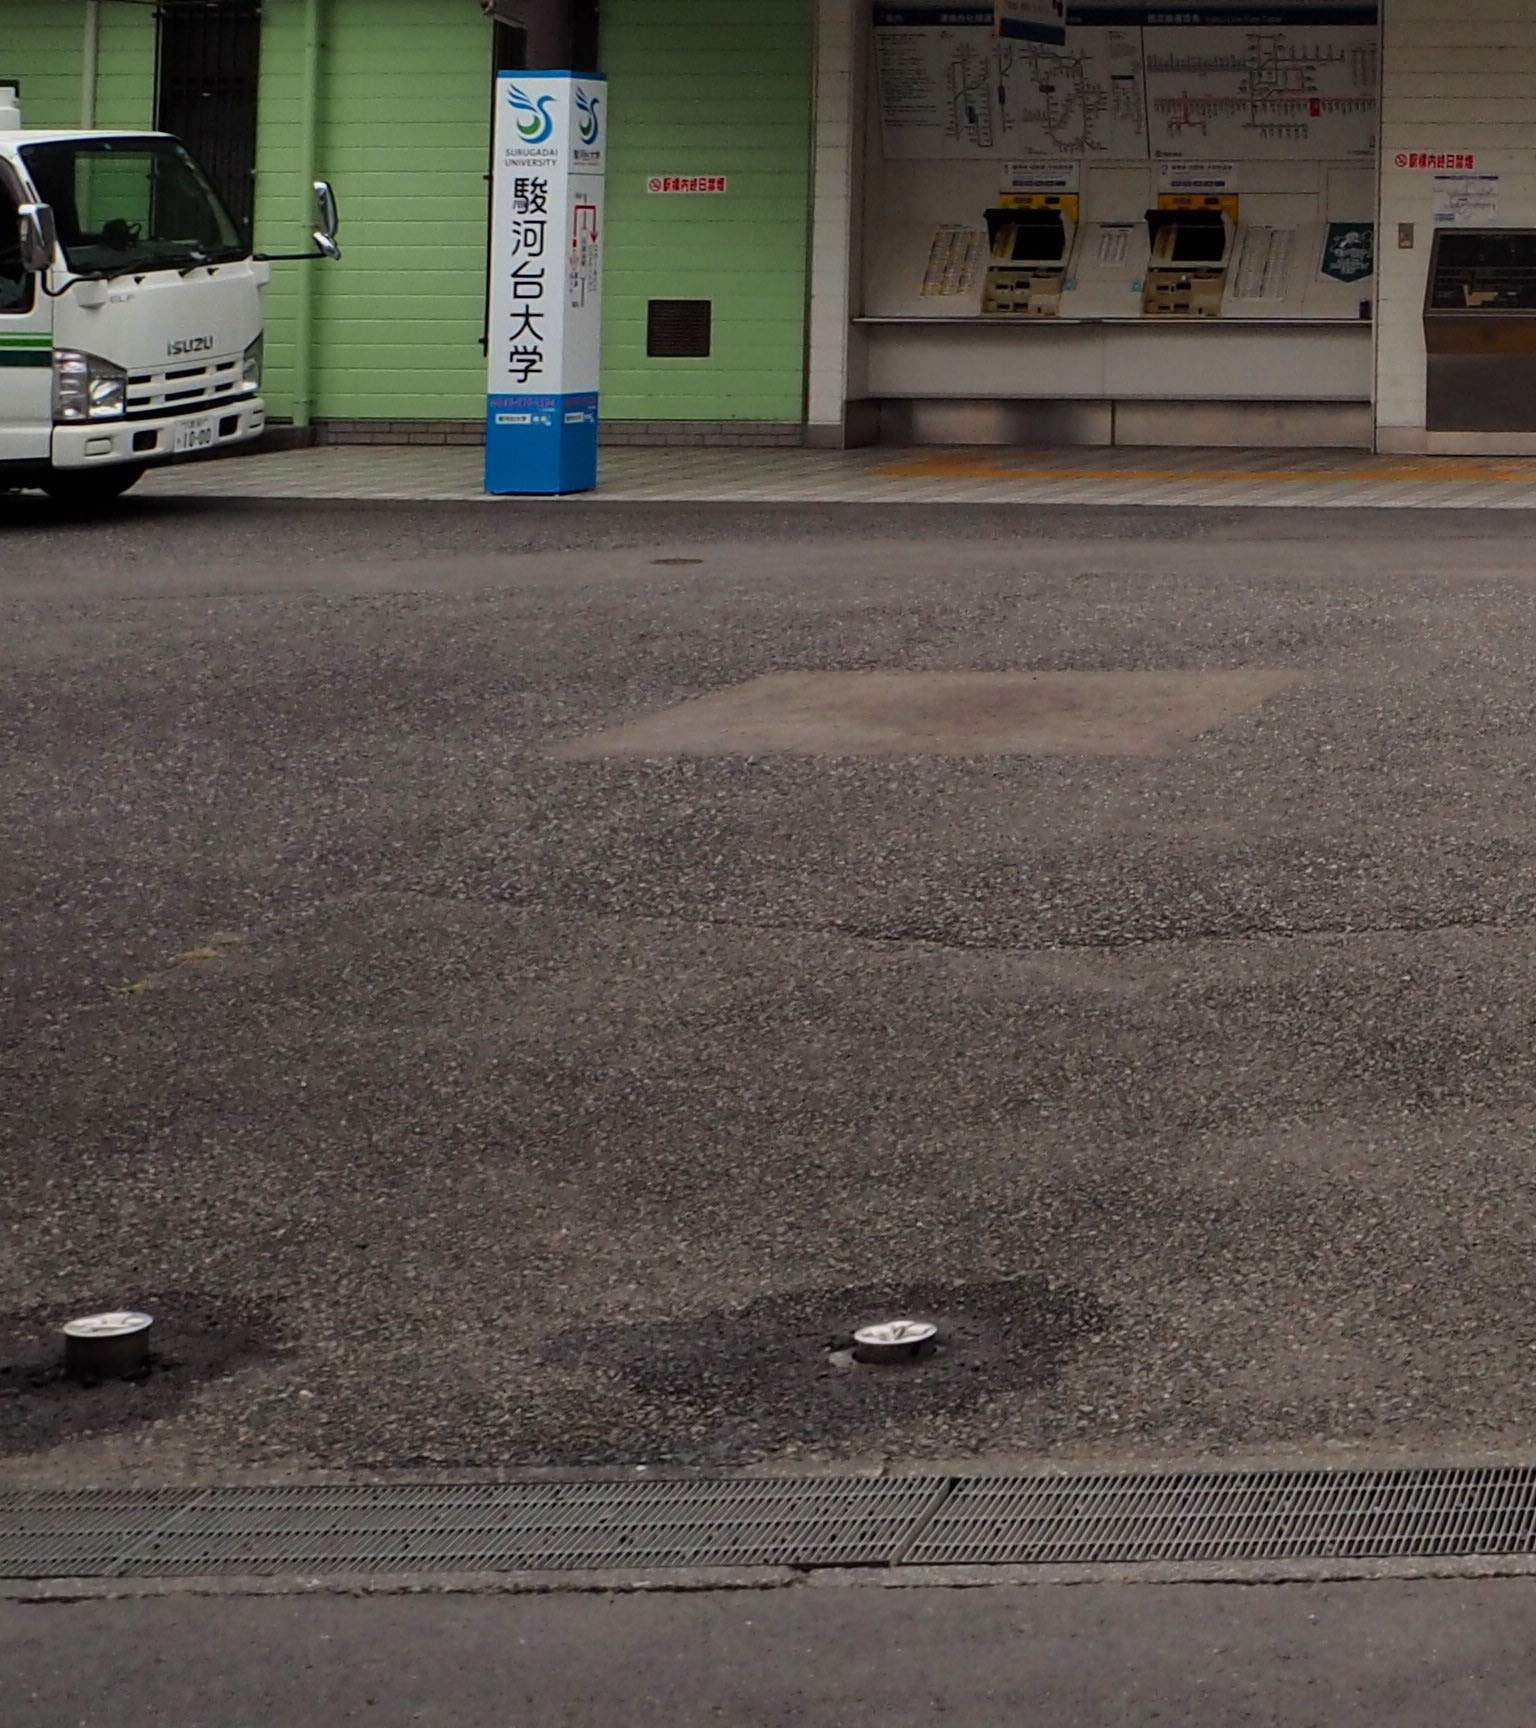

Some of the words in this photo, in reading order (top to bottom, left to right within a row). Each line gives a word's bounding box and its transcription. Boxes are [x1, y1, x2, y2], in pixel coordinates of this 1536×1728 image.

[505, 148, 559, 157] SURUGADAI
[504, 159, 557, 167] UNIVERSITY
[508, 176, 548, 383] 駿河台大学
[168, 336, 214, 356] ISUZU
